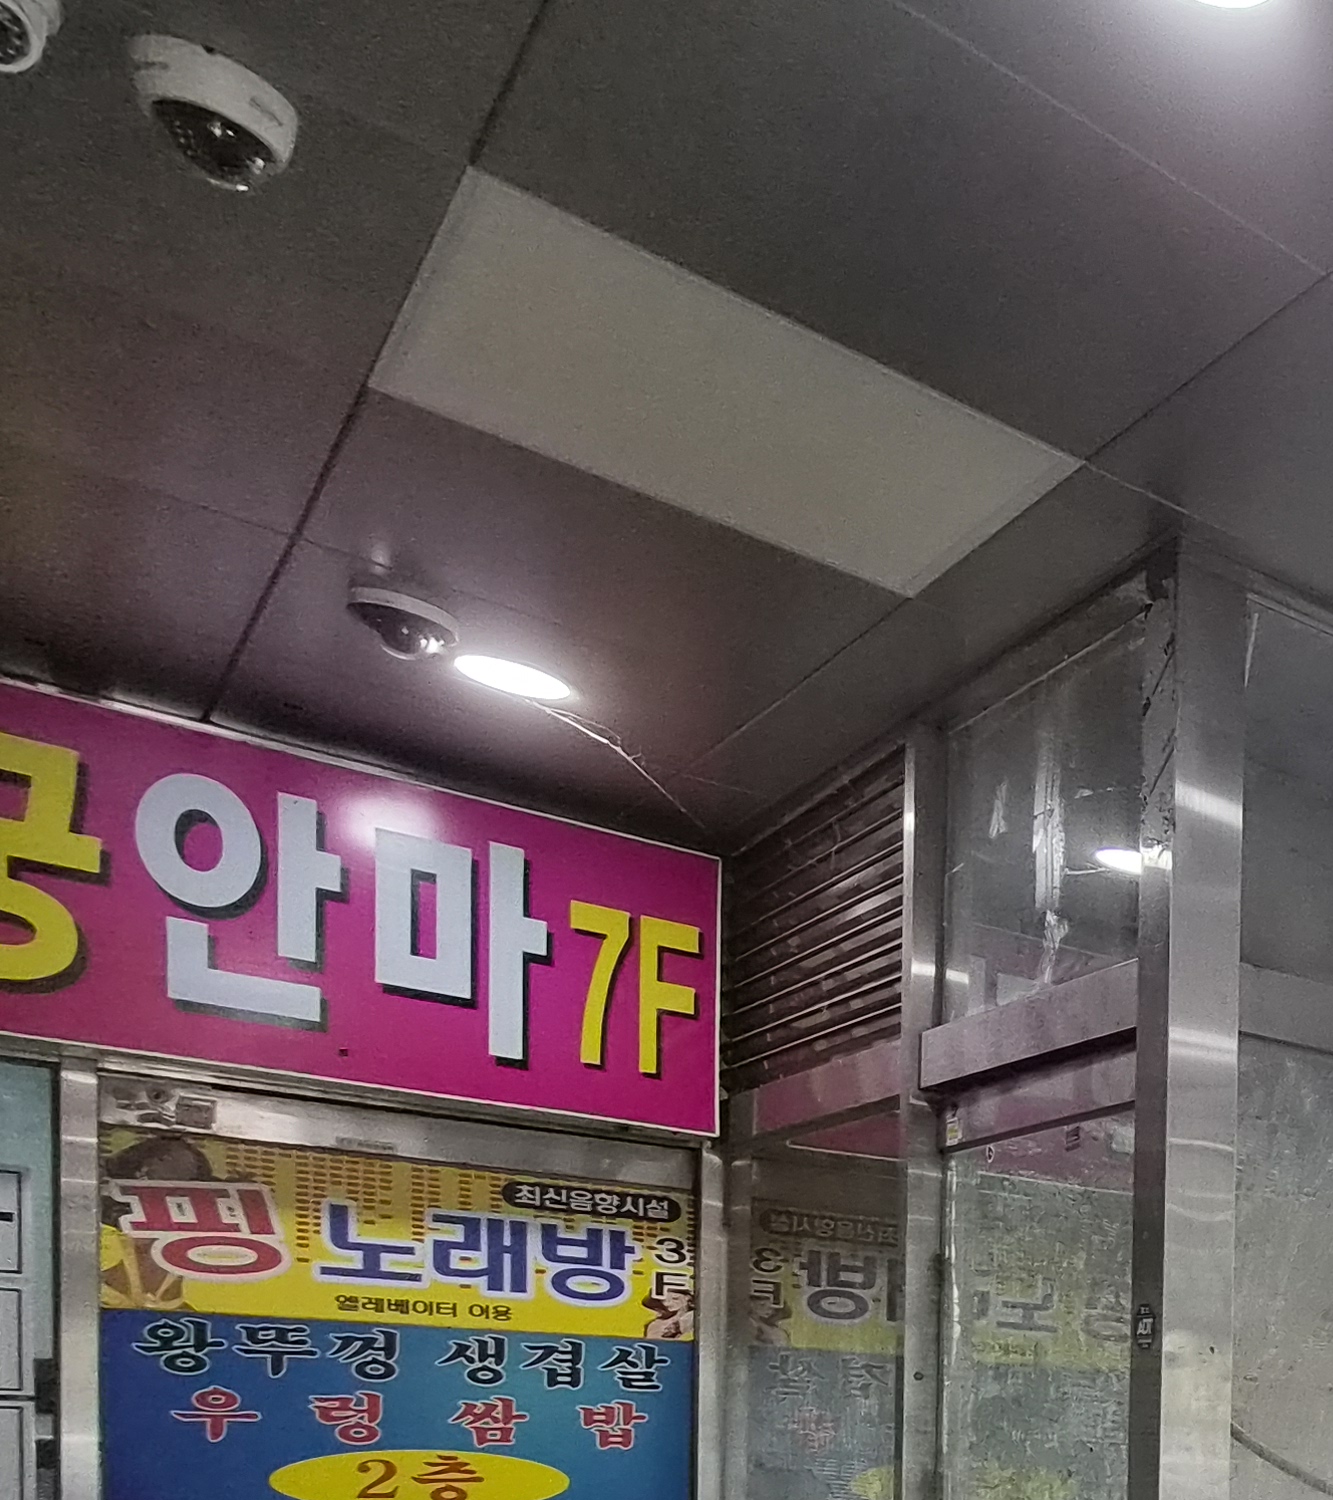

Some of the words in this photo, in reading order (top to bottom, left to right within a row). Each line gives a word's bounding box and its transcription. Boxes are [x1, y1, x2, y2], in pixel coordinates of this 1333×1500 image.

[570, 900, 700, 1075] 7F
[514, 1184, 669, 1217] 최신음향시설
[319, 1202, 636, 1301] 노래방
[335, 1294, 458, 1318] 엘레베이터
[468, 1304, 511, 1321] 이용
[132, 1318, 401, 1382] 왕뚜껑
[435, 1334, 671, 1391] 생겹살
